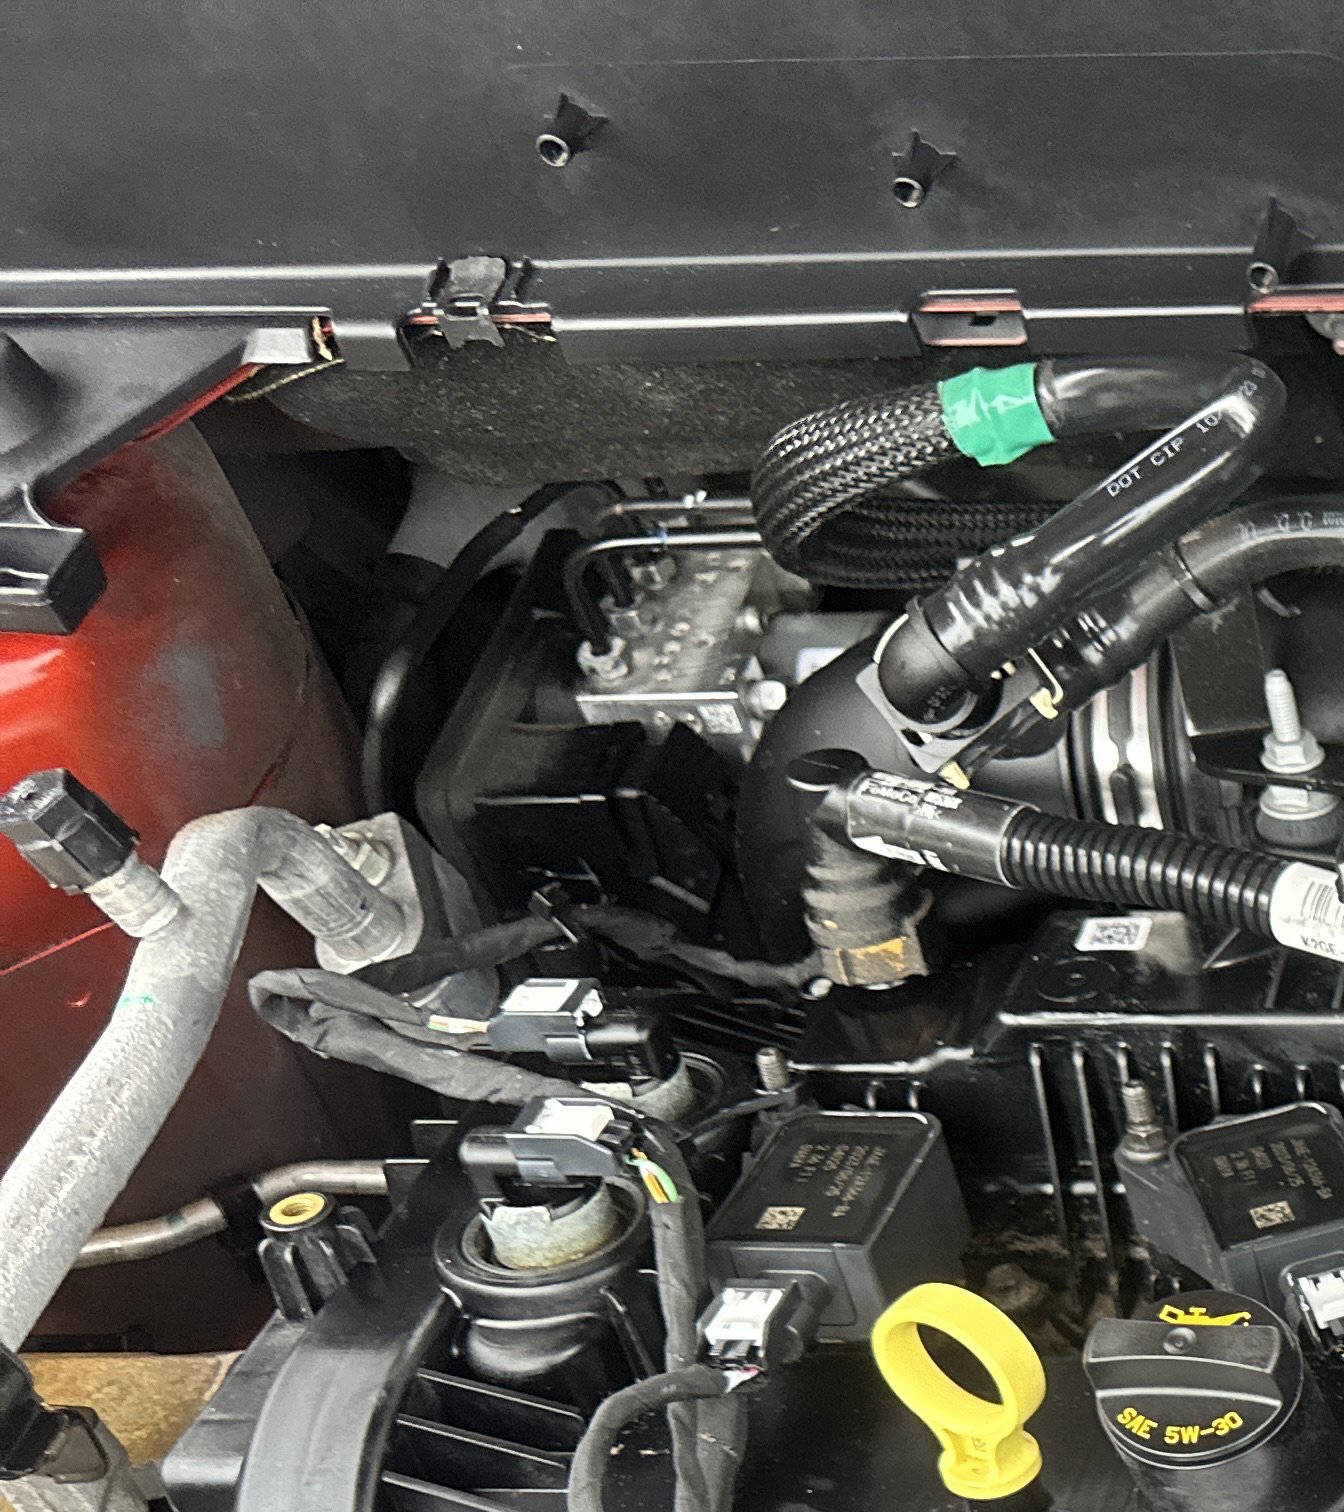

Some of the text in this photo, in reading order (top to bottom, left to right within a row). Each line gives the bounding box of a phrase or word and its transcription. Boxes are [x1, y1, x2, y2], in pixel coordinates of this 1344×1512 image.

[1106, 467, 1143, 497] DOT
[1151, 437, 1185, 467] CIP
[1116, 1407, 1244, 1444] SAE 5W-30
